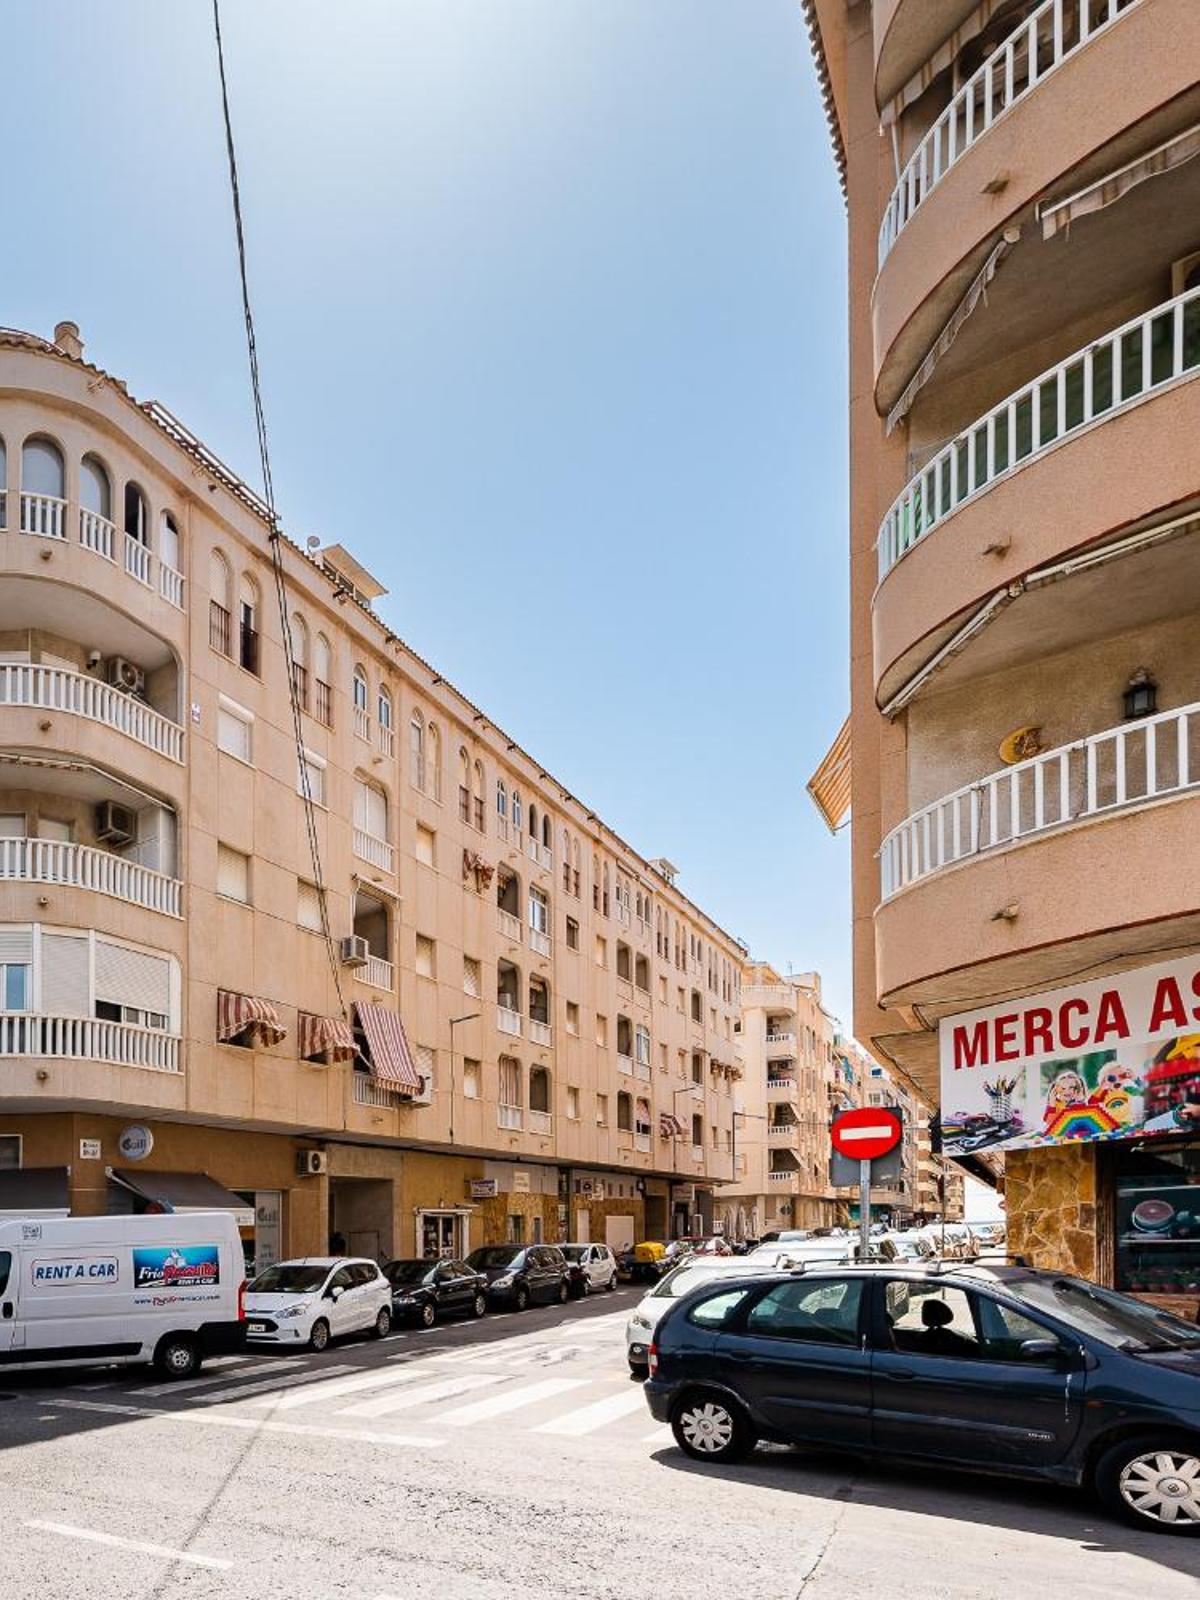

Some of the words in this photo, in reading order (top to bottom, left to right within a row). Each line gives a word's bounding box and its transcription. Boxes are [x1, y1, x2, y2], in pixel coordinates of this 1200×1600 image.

[953, 989, 1130, 1070] MERCA
[1148, 970, 1200, 1033] A
[36, 1265, 73, 1280] RENT
[75, 1264, 85, 1278] A
[88, 1263, 116, 1277] CAR
